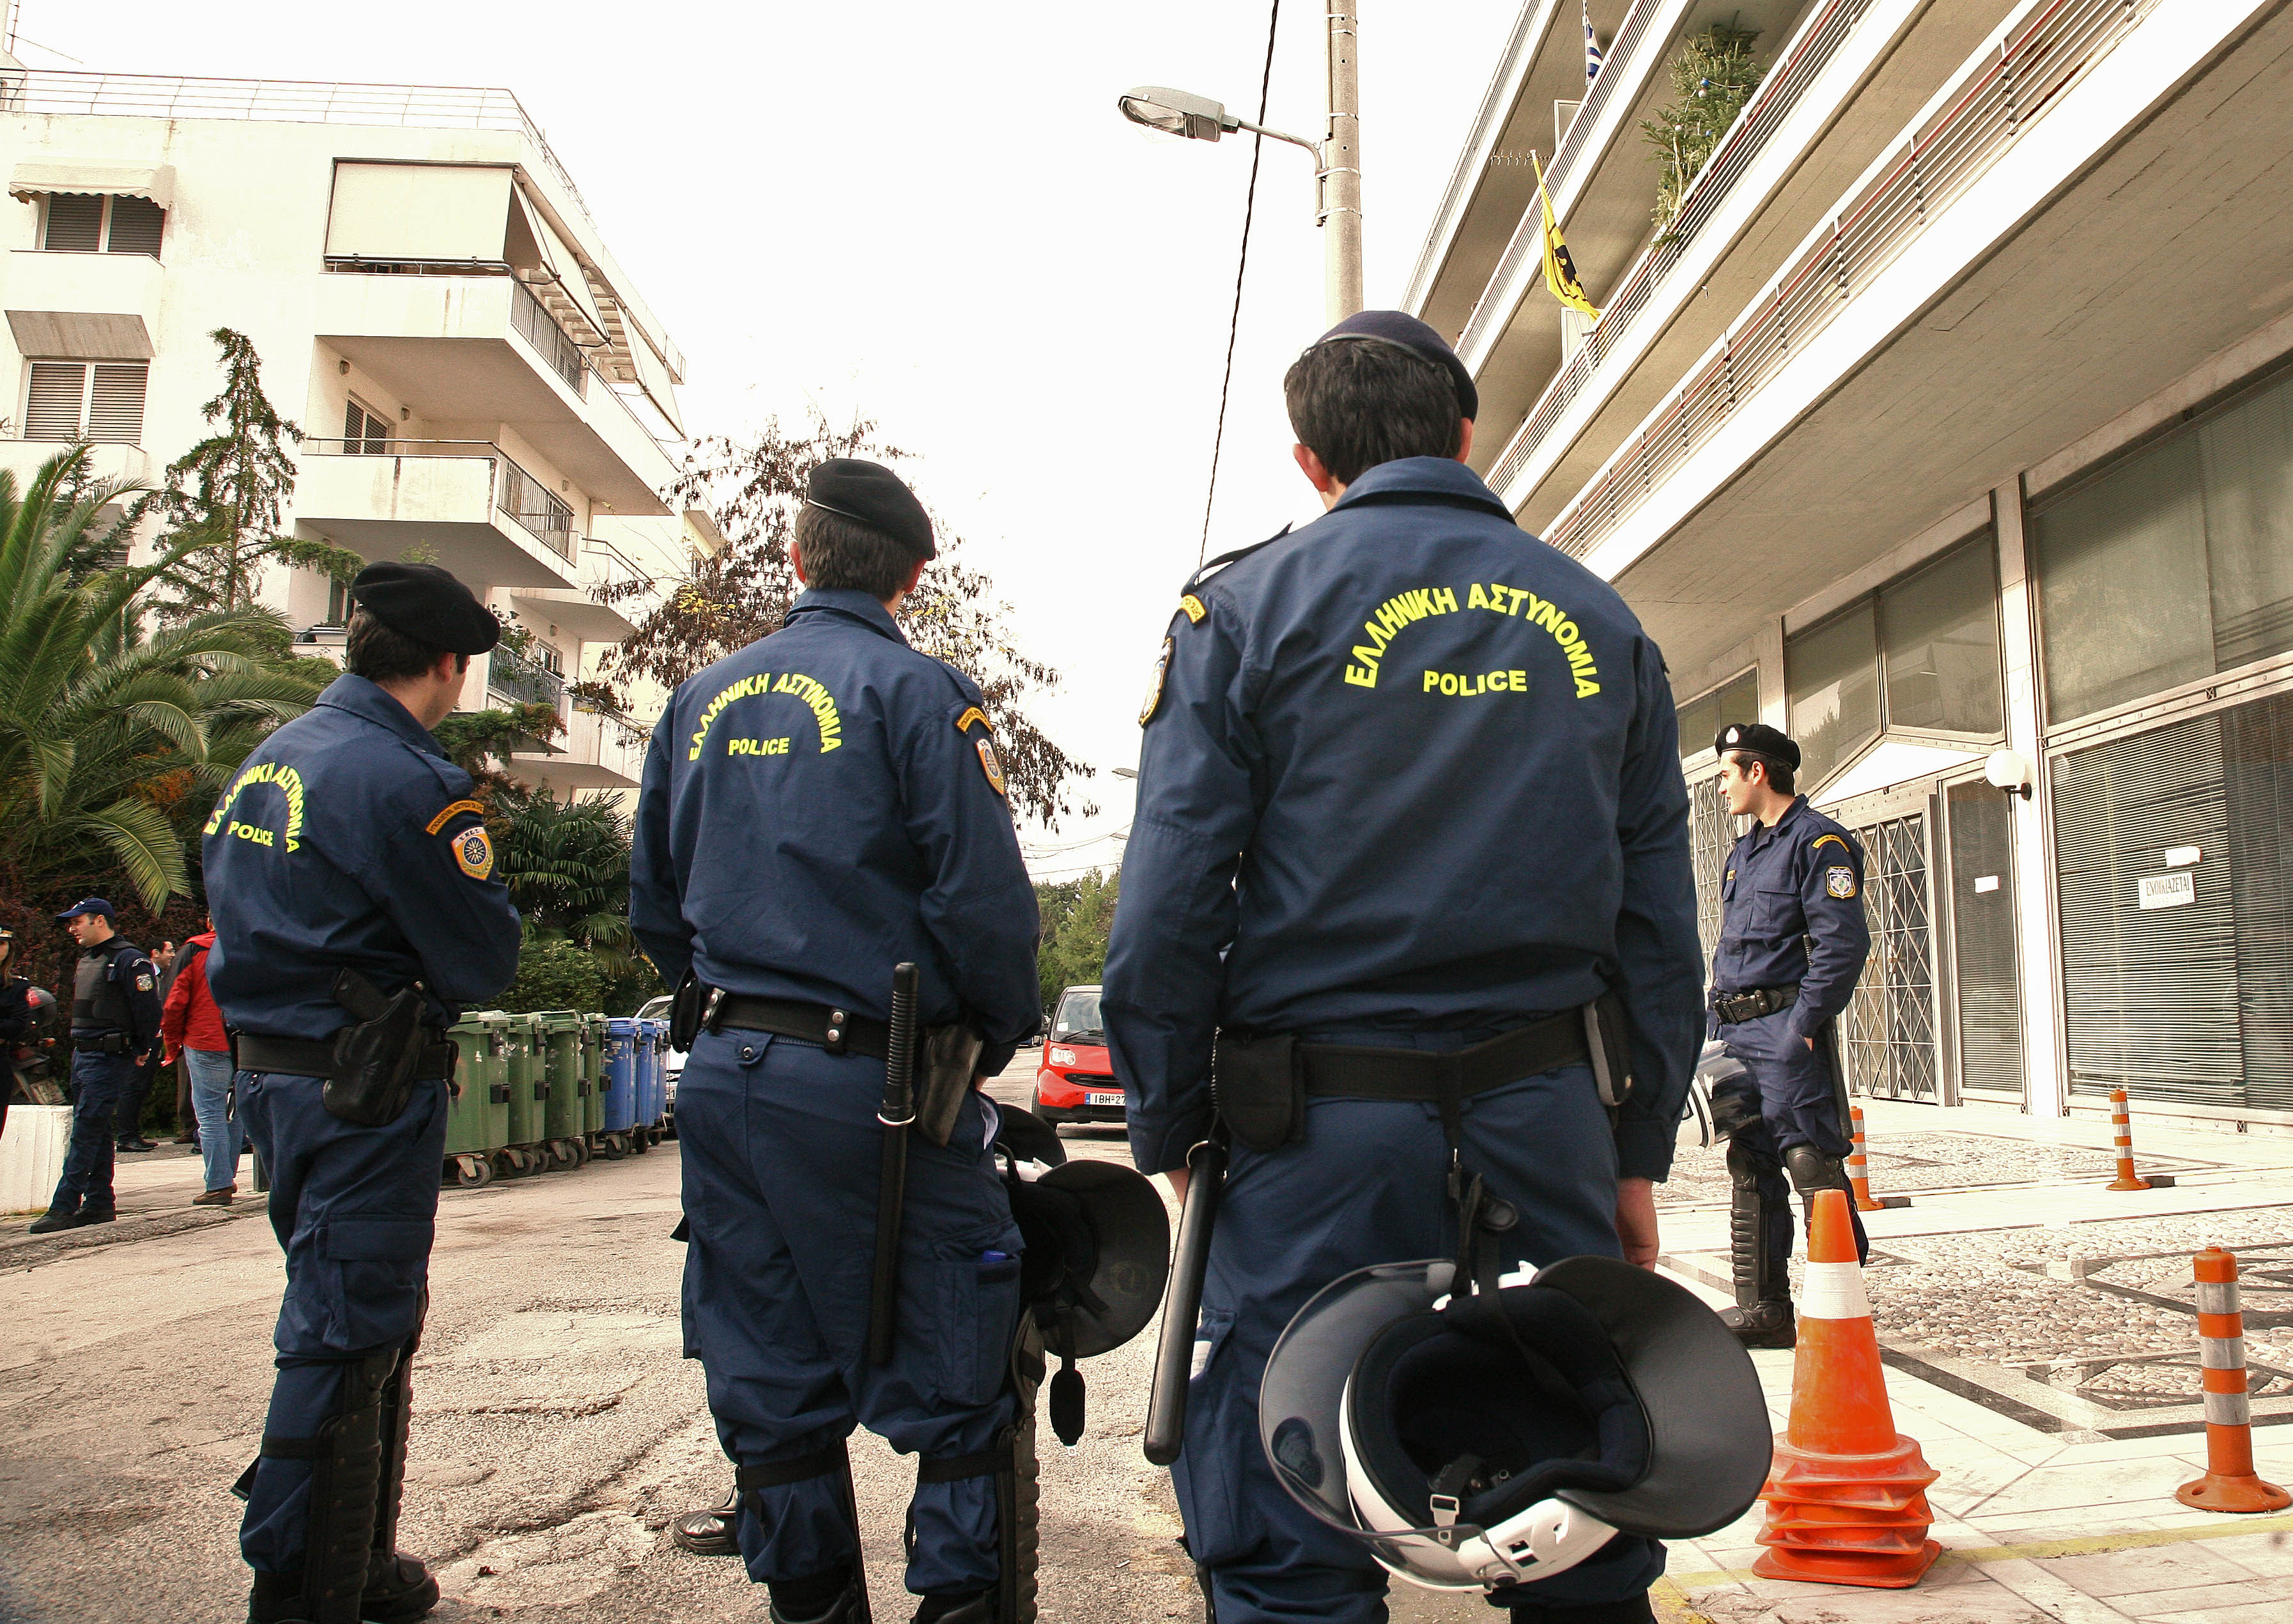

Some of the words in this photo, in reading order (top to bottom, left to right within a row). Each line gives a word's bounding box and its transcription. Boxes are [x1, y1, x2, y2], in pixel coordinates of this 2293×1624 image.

[1344, 586, 1458, 688] ΕΛΛΗΝΙΚΗ
[1467, 583, 1600, 699] ΑΣΤΥΝΟΜΙΑ
[1423, 670, 1527, 696] POLICE
[688, 672, 771, 761] ΕΛΛΗΝΙΚΗ
[771, 672, 842, 754] ΑΣΤΥΝΟΜΙΑ
[728, 737, 790, 756] POLICE
[227, 821, 274, 847] POLICE
[2146, 875, 2190, 896] ΕΝΟΙΚΙΑΖΕΤΑΙ
